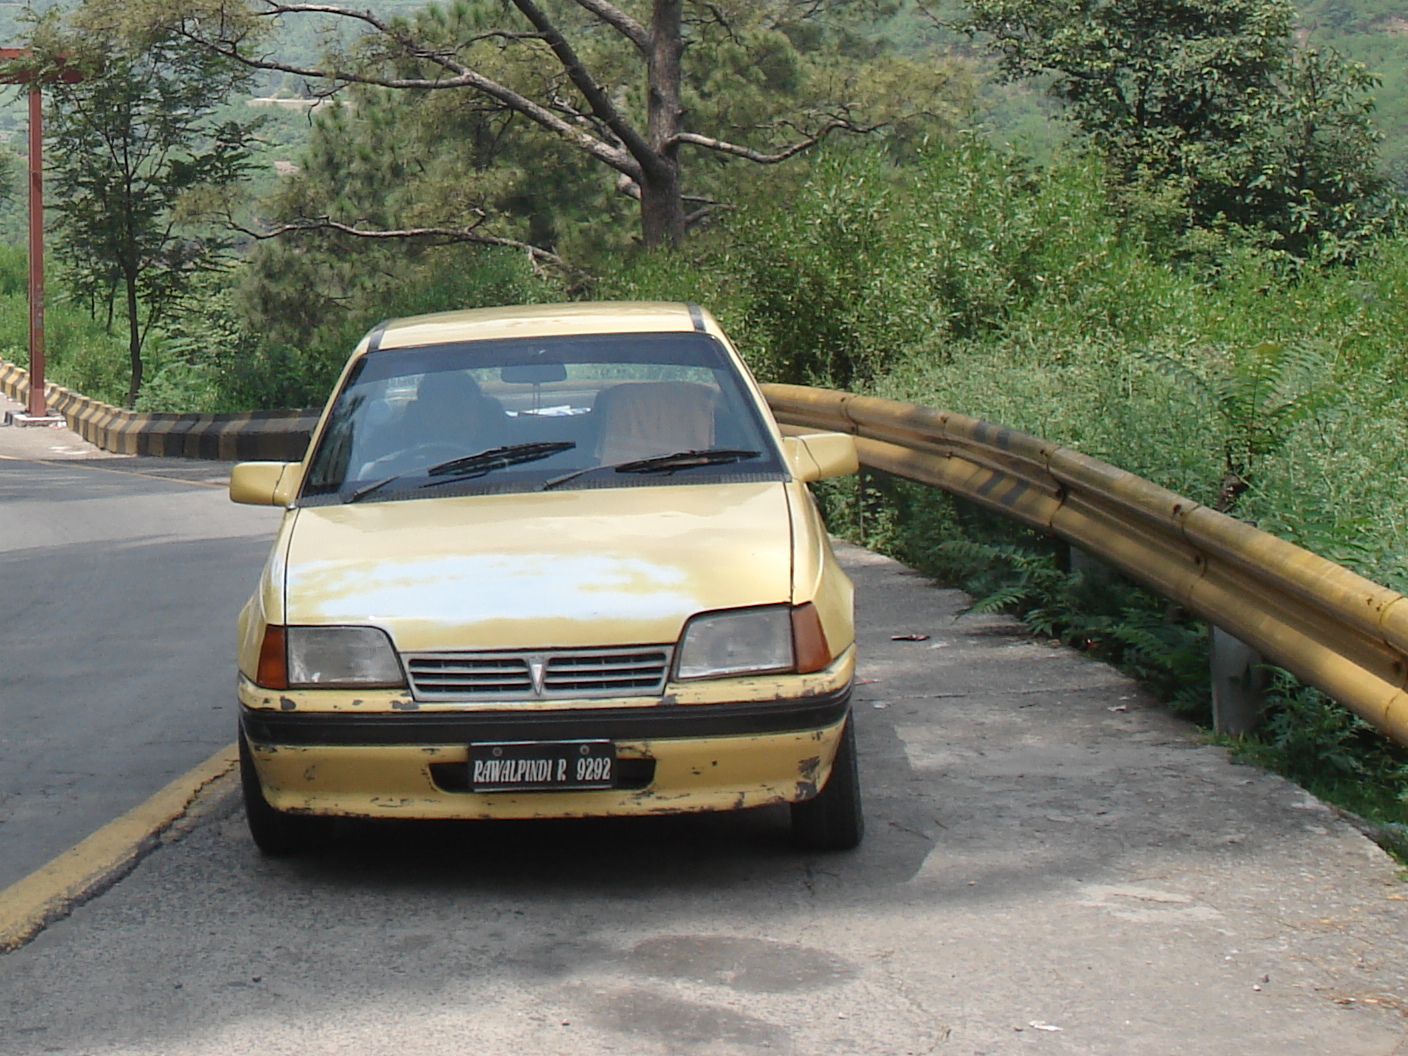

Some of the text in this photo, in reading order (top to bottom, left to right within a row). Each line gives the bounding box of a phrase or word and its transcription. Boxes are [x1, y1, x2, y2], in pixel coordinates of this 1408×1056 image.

[473, 757, 612, 783] RAWALPINDI R 9292
